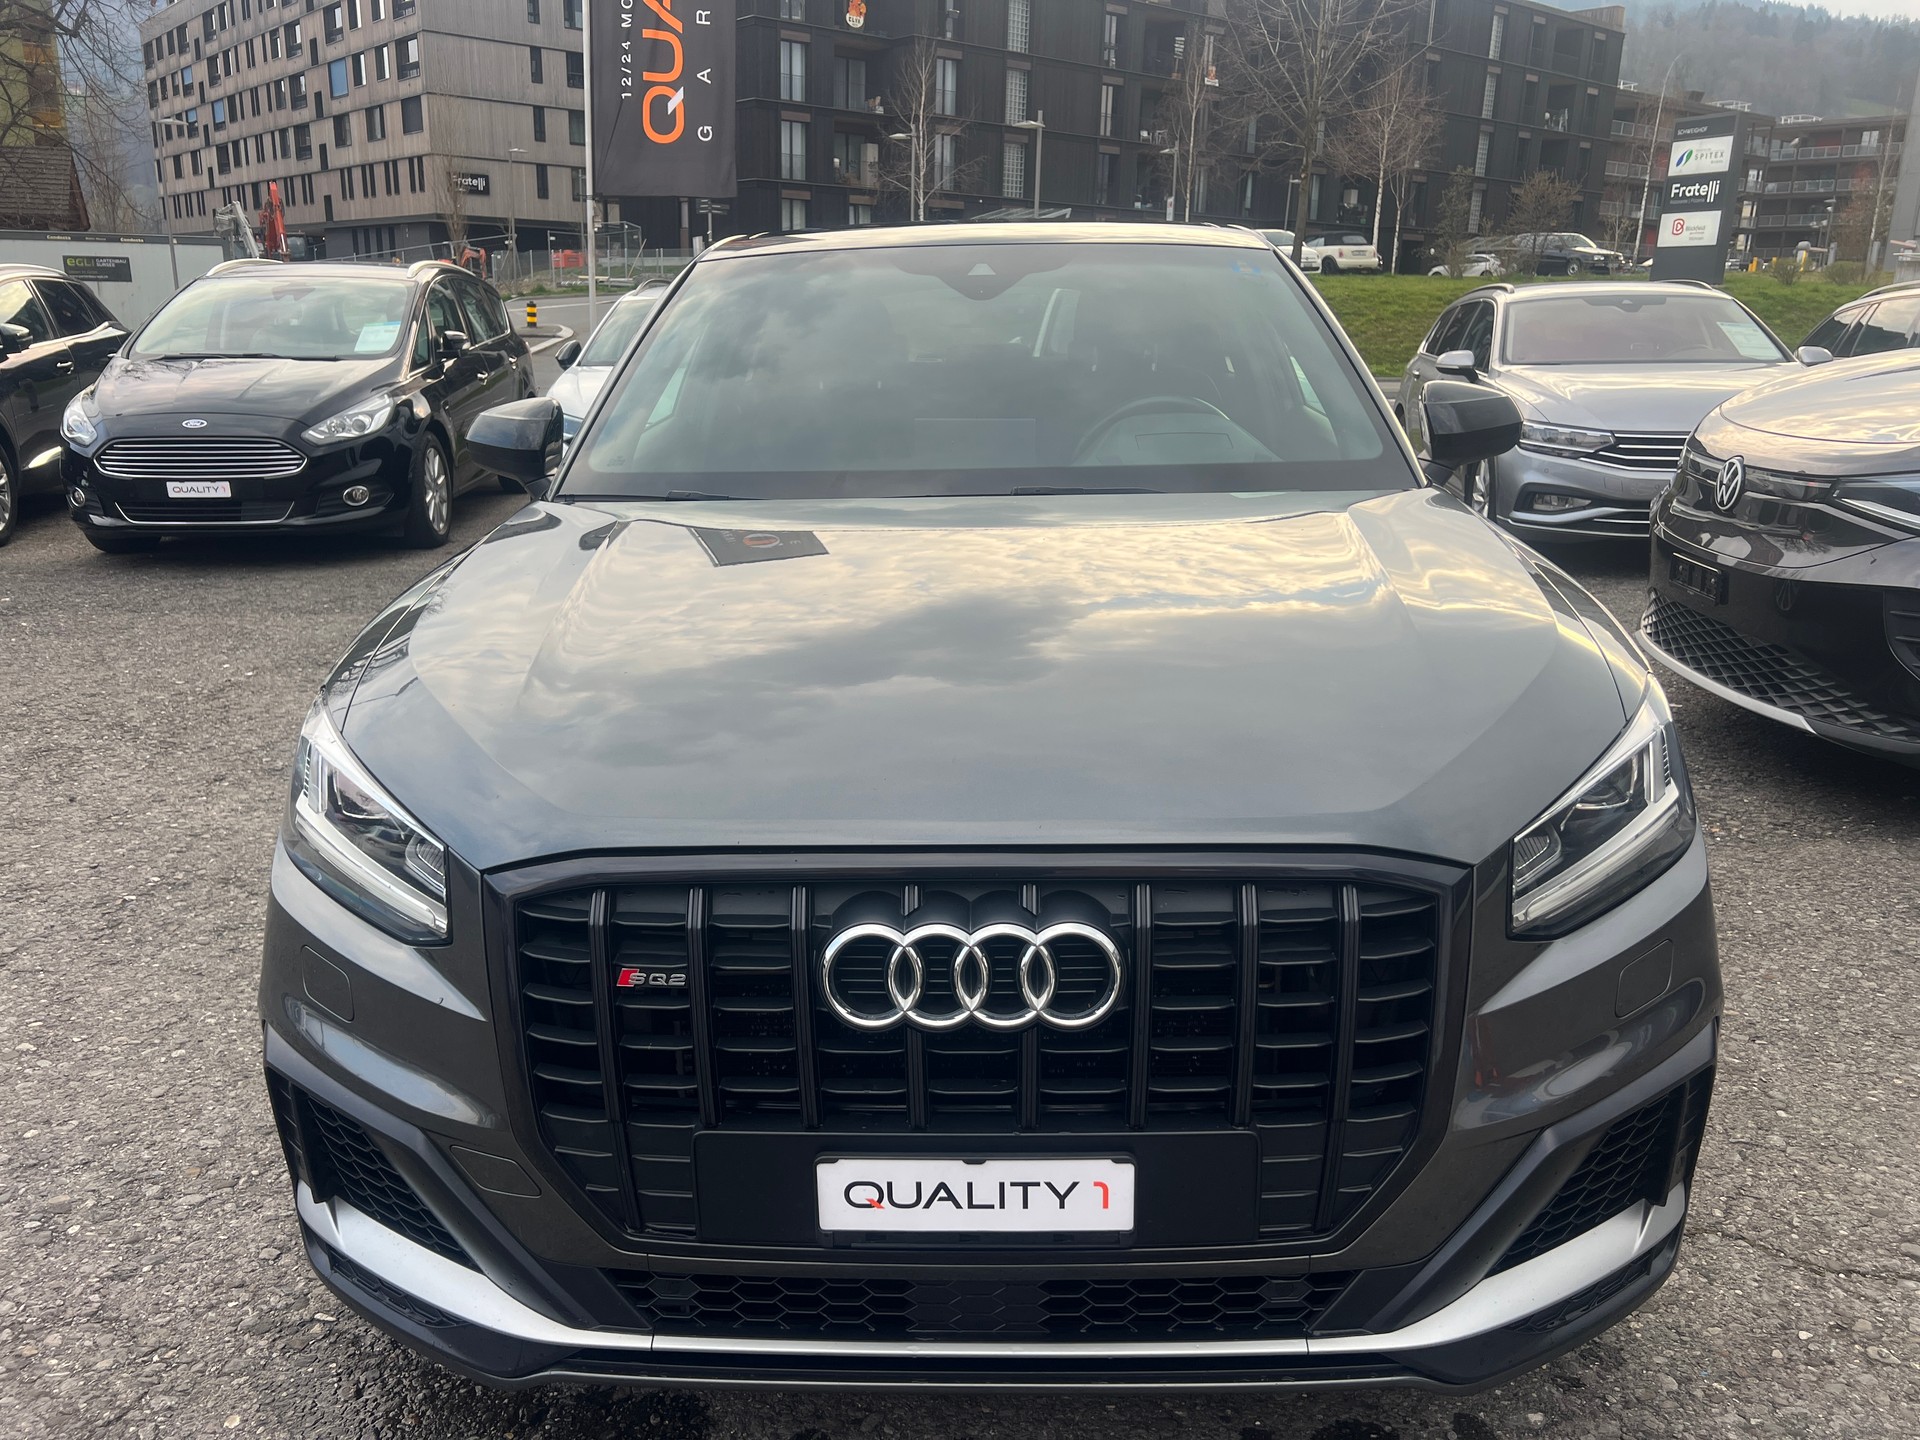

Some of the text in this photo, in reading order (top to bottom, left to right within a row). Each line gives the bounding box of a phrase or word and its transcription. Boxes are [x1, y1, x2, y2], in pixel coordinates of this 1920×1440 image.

[621, 41, 633, 100] 12/24
[642, 0, 686, 145] QUA
[1694, 151, 1725, 161] SPITEX
[1670, 180, 1721, 203] Fratelli
[172, 486, 220, 494] QUALITY
[627, 972, 687, 987] SQ2
[843, 1180, 1110, 1210] QUALITY 1
